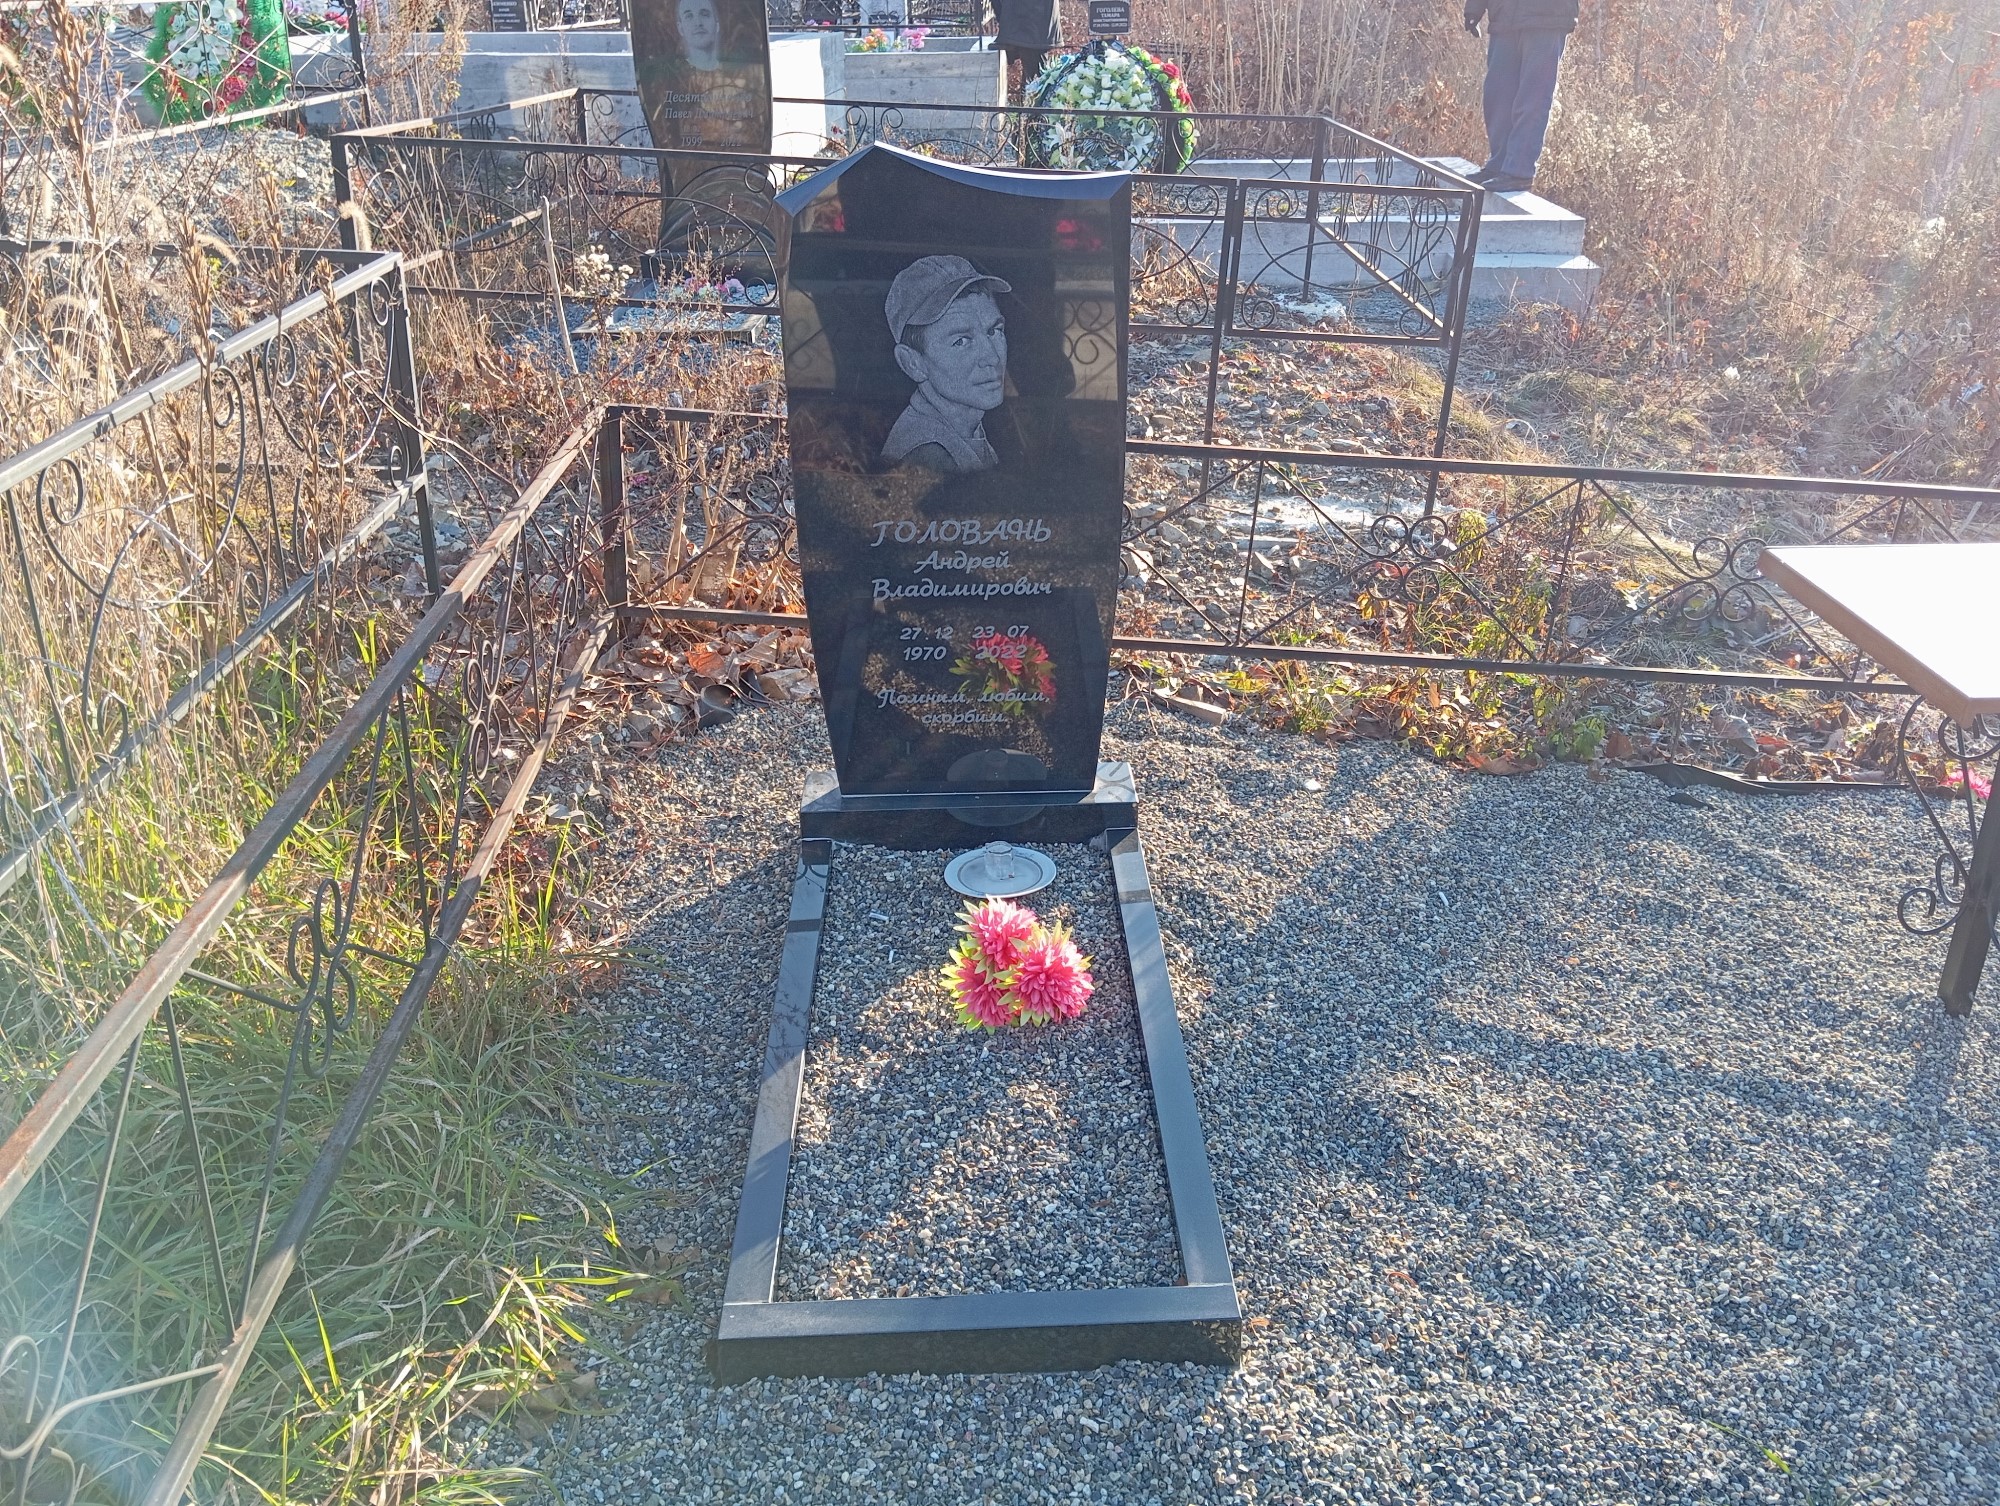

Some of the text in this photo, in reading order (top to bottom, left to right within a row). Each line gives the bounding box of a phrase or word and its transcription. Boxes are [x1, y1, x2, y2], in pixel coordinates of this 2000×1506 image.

[664, 108, 692, 119] Павел
[681, 136, 703, 147] 1999
[871, 518, 1051, 547] ГОЛОВАНЬ
[914, 550, 1011, 574] Андрей
[871, 576, 1053, 600] Владимирович
[903, 644, 1028, 661] 1970 2022
[877, 687, 1050, 709] Помним, любим,
